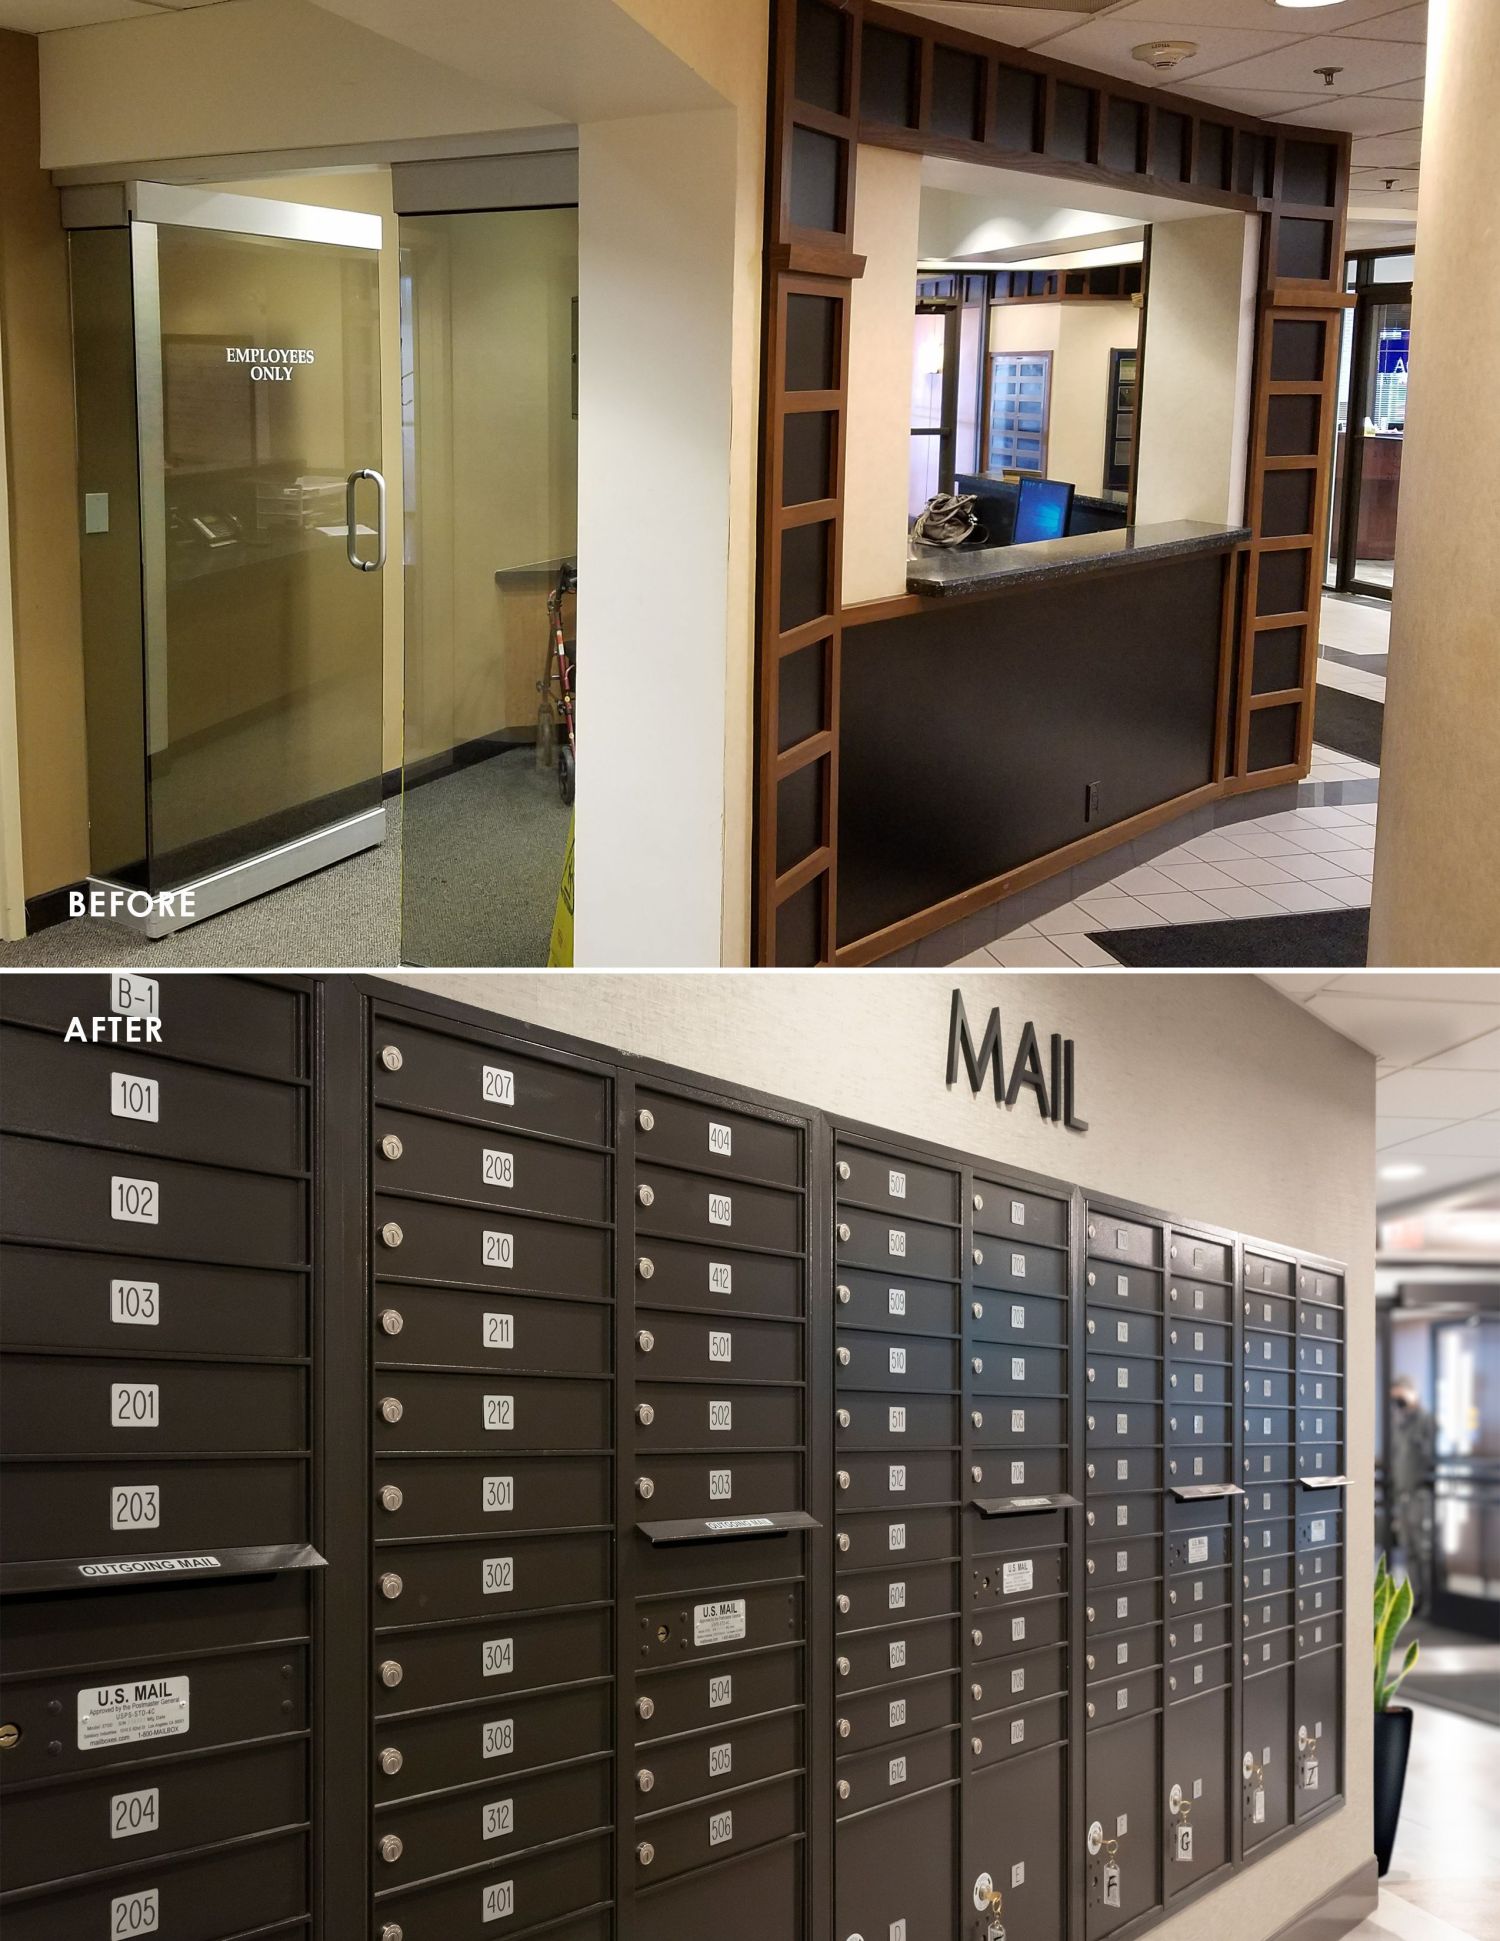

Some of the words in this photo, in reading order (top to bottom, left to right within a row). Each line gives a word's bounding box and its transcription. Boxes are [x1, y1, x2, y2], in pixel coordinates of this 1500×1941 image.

[226, 348, 314, 364] EMPLOYEES
[250, 366, 293, 381] ONLY
[119, 977, 153, 1014] B-1
[946, 988, 1089, 1132] MAIL
[120, 1080, 151, 1114] 101
[485, 1071, 512, 1099] 207
[710, 1127, 730, 1151] 404
[485, 1154, 512, 1182] 208
[890, 1174, 904, 1194] 507
[117, 1183, 153, 1217] 102
[710, 1198, 730, 1222] 408
[486, 1236, 511, 1263] 210
[890, 1233, 904, 1253] 508
[711, 1267, 729, 1289] 412
[118, 1286, 155, 1319] 103
[890, 1292, 904, 1312] 509
[488, 1317, 509, 1343] 211
[711, 1336, 730, 1358] 501
[891, 1351, 905, 1370] 510
[118, 1389, 154, 1420] 201
[487, 1399, 510, 1425] 212
[711, 1404, 730, 1426] 502
[891, 1410, 904, 1429] 511
[711, 1474, 730, 1496] 503
[891, 1468, 904, 1488] 512
[486, 1481, 511, 1506] 301
[116, 1491, 157, 1523] 203
[890, 1527, 904, 1547] 601
[82, 1560, 175, 1576] OUTGOING
[176, 1557, 219, 1568] MAIL
[485, 1561, 511, 1589] 302
[890, 1585, 904, 1606] 604
[703, 1605, 718, 1618] U.S.
[720, 1603, 738, 1615] MAIL
[485, 1642, 511, 1671] 304
[891, 1644, 904, 1665] 605
[98, 1688, 129, 1707] U.S.
[135, 1682, 172, 1701] MAIL
[711, 1679, 730, 1704] 504
[89, 1706, 115, 1716] Approved
[115, 1705, 121, 1713] by
[122, 1703, 131, 1711] the
[131, 1700, 160, 1709] Postmaster
[160, 1697, 180, 1705] General
[891, 1703, 905, 1724] 608
[485, 1724, 512, 1753] 308
[711, 1748, 730, 1772] 505
[891, 1760, 905, 1781] 612
[115, 1794, 155, 1832] 204
[487, 1804, 510, 1834] 312
[711, 1815, 731, 1841] 506
[1107, 1875, 1117, 1897] F
[486, 1885, 511, 1914] 401
[115, 1896, 156, 1934] 205
